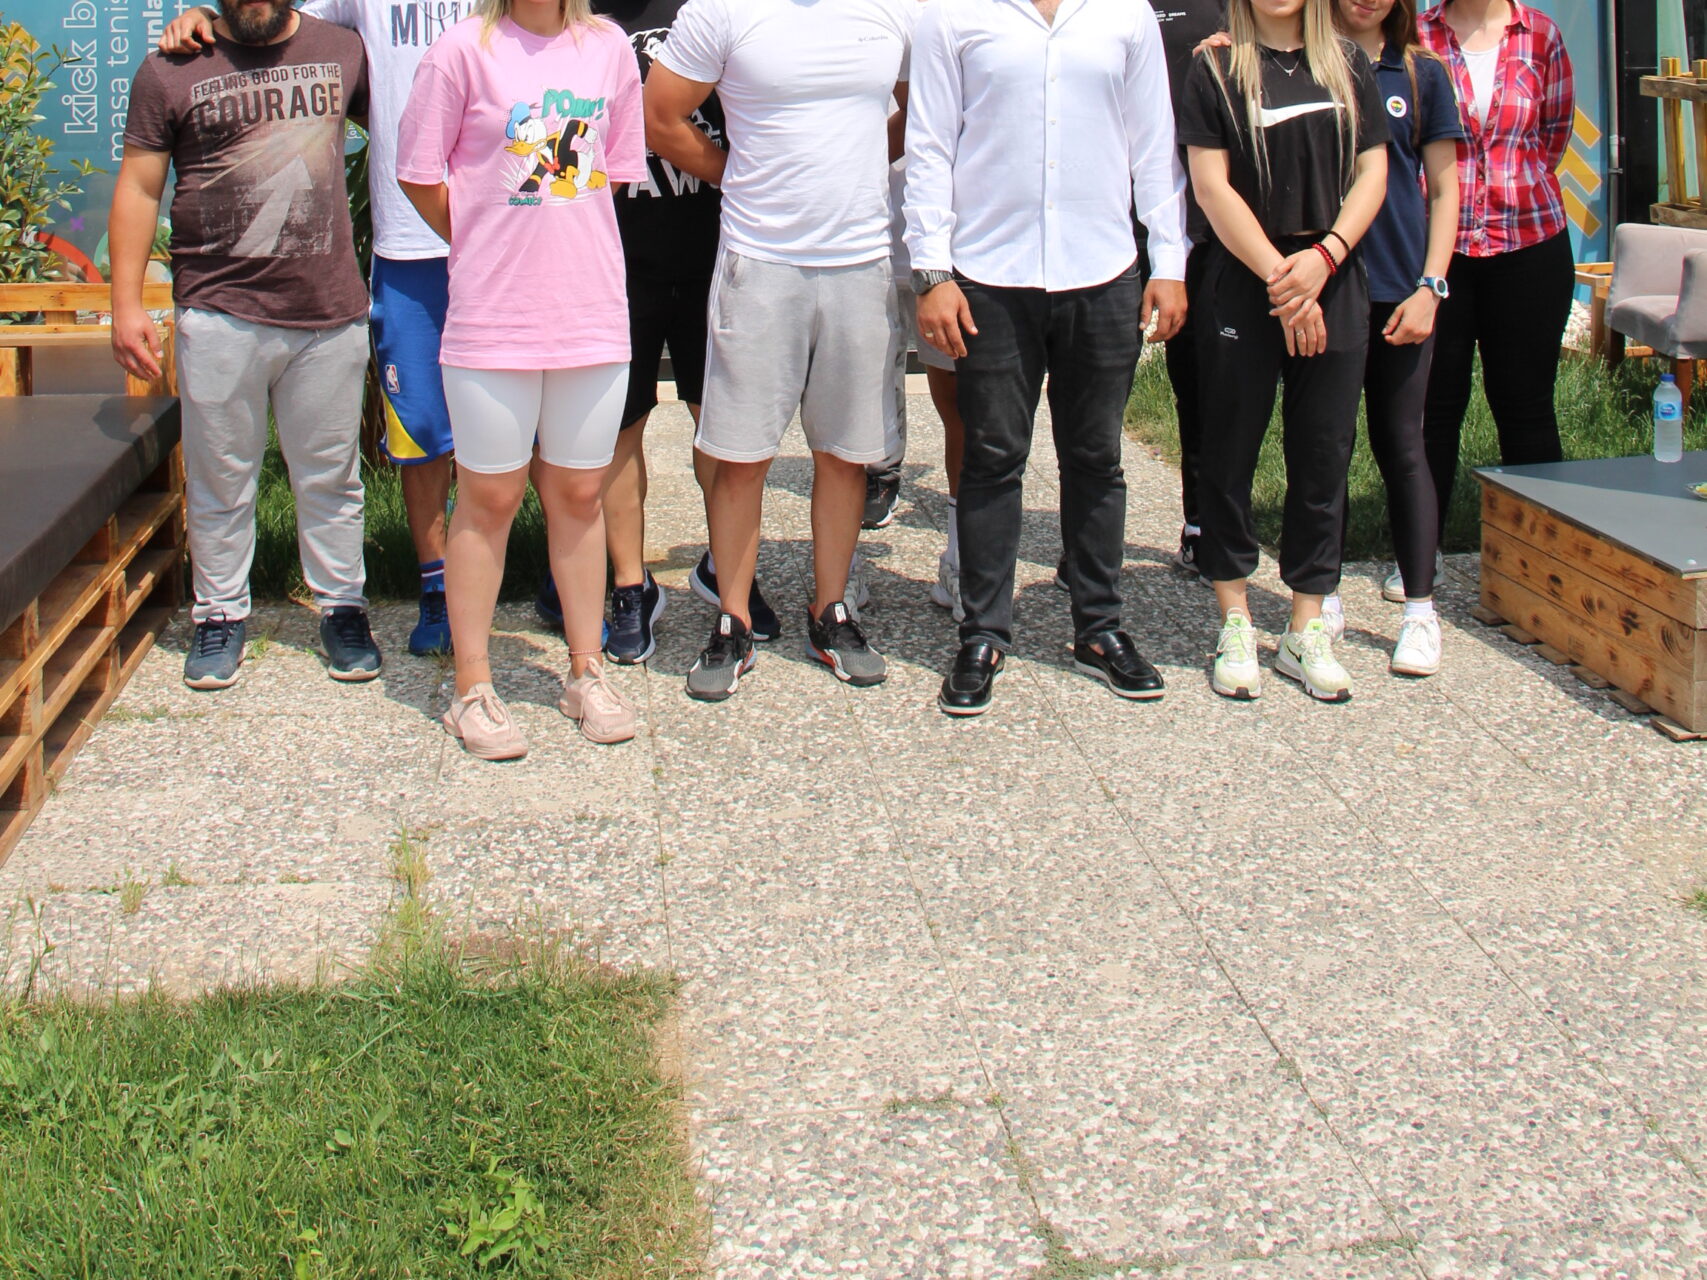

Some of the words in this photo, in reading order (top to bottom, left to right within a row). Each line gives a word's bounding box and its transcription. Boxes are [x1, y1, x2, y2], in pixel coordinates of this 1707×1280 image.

[62, 39, 98, 134] kick
[193, 73, 248, 99] FEELING
[251, 68, 289, 85] GOOD
[293, 65, 318, 80] FOR
[320, 64, 340, 79] THE
[541, 88, 606, 121] POW!
[110, 77, 129, 162] masa
[197, 83, 341, 131] COURAGE
